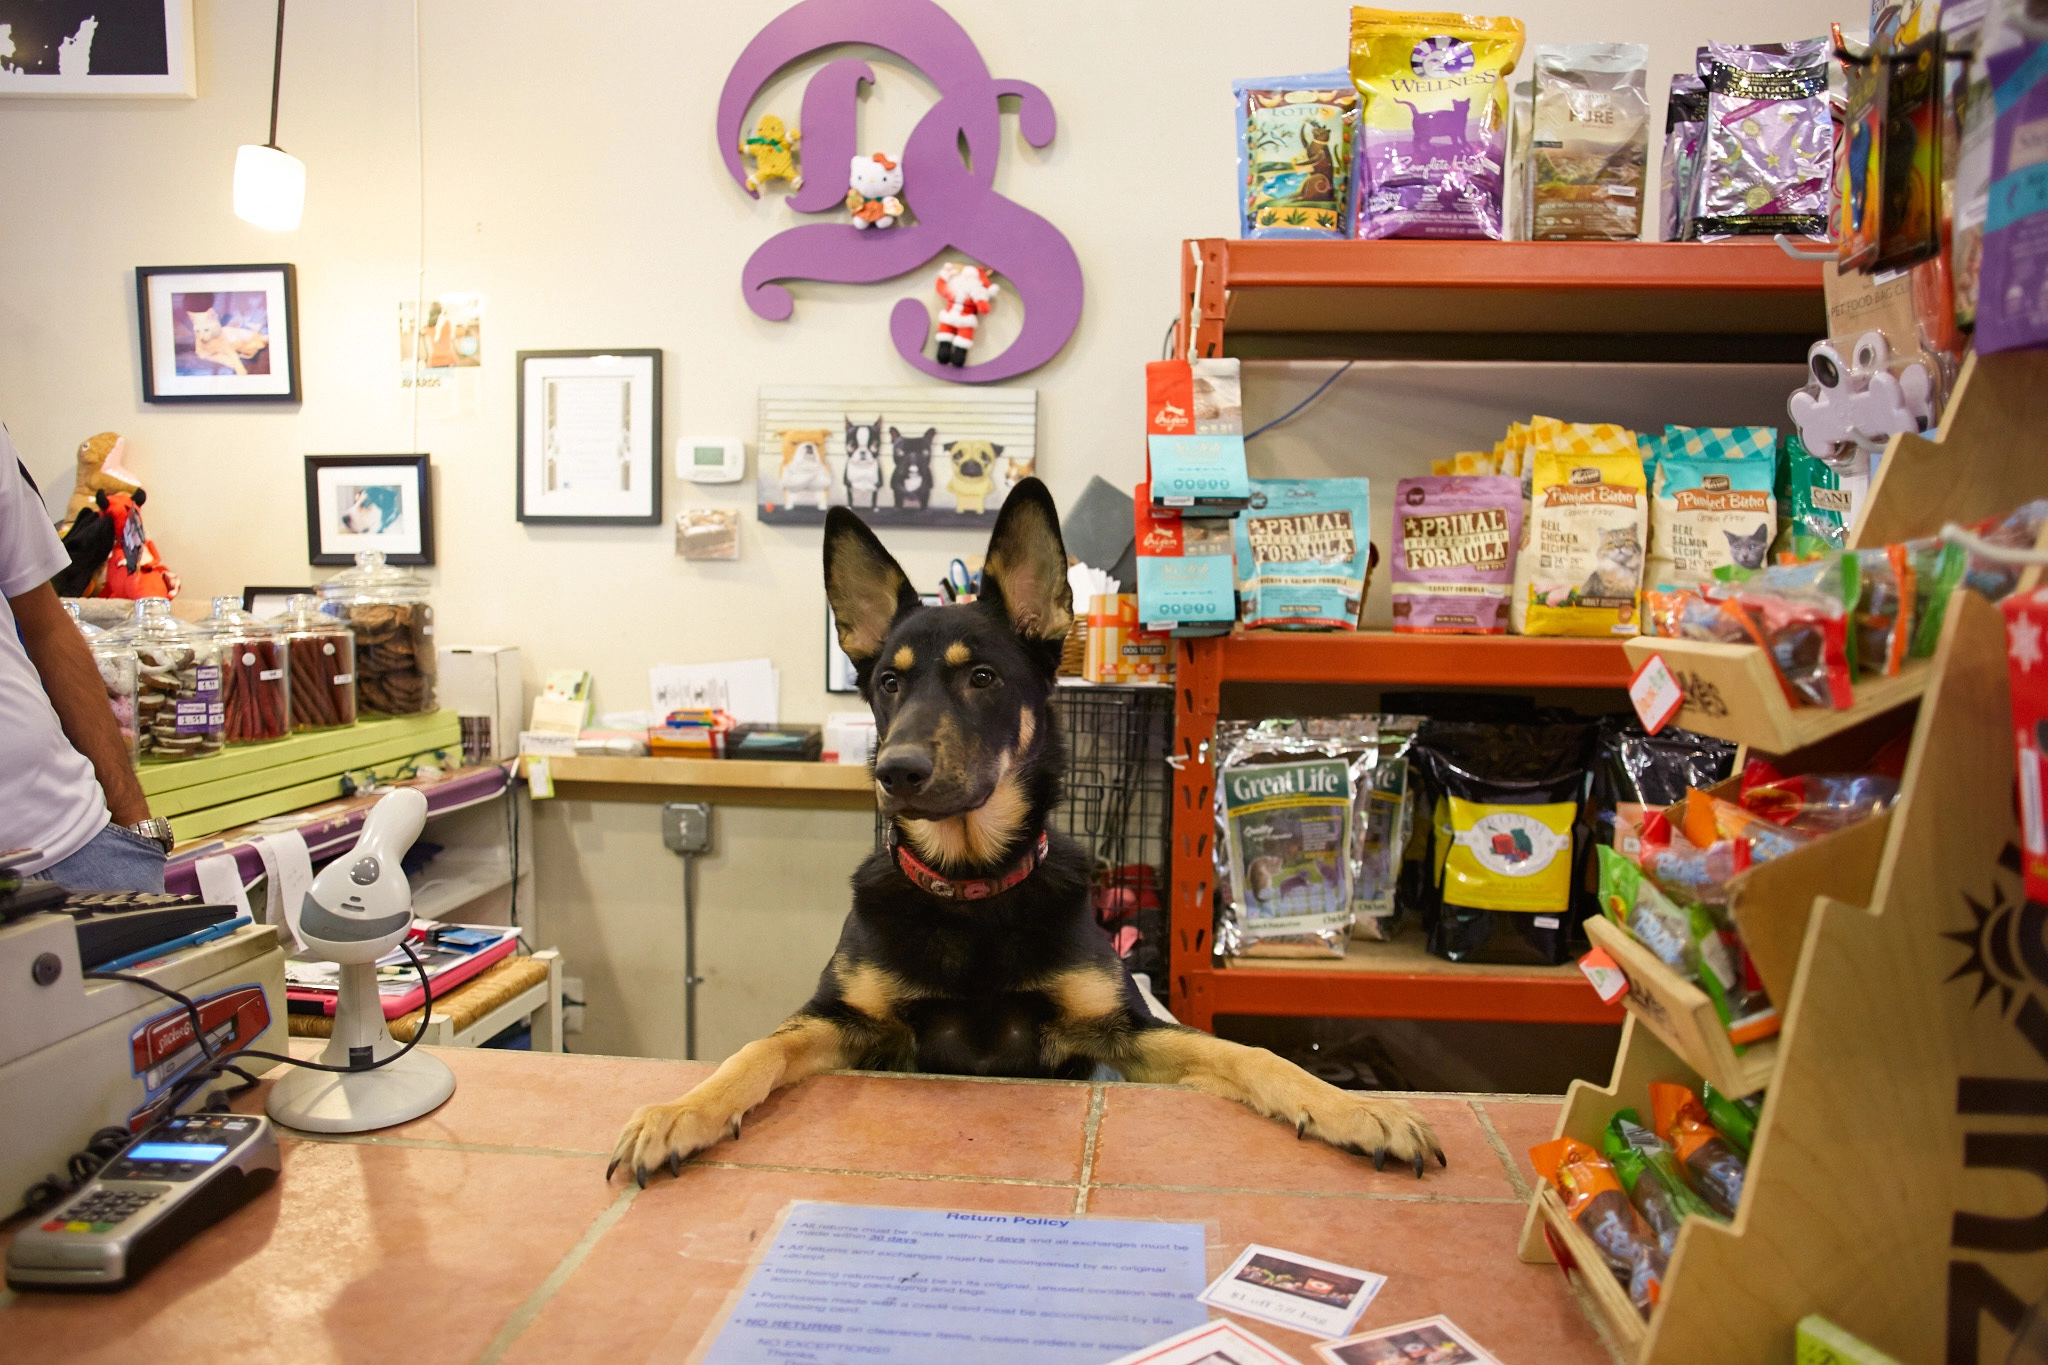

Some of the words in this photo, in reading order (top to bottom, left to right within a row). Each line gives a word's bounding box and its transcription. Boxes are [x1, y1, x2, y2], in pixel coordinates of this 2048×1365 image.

[1391, 69, 1497, 93] WELLNESS
[1272, 107, 1330, 117] LOTUS
[1569, 109, 1614, 126] PURE
[1831, 303, 1845, 317] PET
[1847, 294, 1873, 313] FOOD
[1874, 287, 1893, 304] BAG
[1265, 512, 1348, 535] PRIMAL
[1421, 511, 1504, 538] PRIMAL
[1541, 520, 1561, 530] REAL
[1672, 524, 1693, 536] REAL
[1541, 532, 1578, 543] CHICKEN
[1672, 536, 1708, 548] SALMON
[1257, 538, 1353, 562] FORMULA
[1410, 541, 1506, 570] FORMULA
[1541, 543, 1569, 554] RECIPE
[1672, 547, 1703, 559] RECIPE
[1123, 646, 1138, 655] DOG
[1140, 646, 1166, 655] TREATS
[1234, 770, 1295, 801] Great
[1296, 765, 1340, 793] Life
[947, 1212, 1007, 1223] Return
[1014, 1216, 1069, 1228] Policy
[818, 1224, 859, 1232] returns
[948, 1232, 981, 1240] within
[985, 1234, 992, 1242] 7
[995, 1235, 1026, 1244] days
[1072, 1240, 1137, 1249] exchanges
[869, 1234, 884, 1243] 30
[887, 1236, 917, 1245] days
[807, 1246, 848, 1255] returns
[878, 1251, 943, 1261] exchanges
[946, 1254, 976, 1262] must
[979, 1256, 994, 1264] be
[997, 1257, 1079, 1269] accompanied
[1083, 1262, 1098, 1271] by
[1120, 1265, 1166, 1273] original
[770, 1275, 860, 1288] accompanying
[863, 1282, 928, 1293] packaging
[930, 1286, 956, 1294] and
[805, 1270, 839, 1279] being
[842, 1272, 895, 1281] returned
[898, 1276, 929, 1284] must
[1036, 1285, 1085, 1293] unused
[1087, 1287, 1146, 1297] condition
[761, 1291, 828, 1303] Purchases
[831, 1297, 868, 1305] made
[871, 1298, 897, 1306] with
[912, 1302, 948, 1310] credit
[951, 1304, 981, 1313] card
[984, 1307, 1016, 1315] must
[1040, 1311, 1129, 1322] accompanied
[1132, 1315, 1148, 1324] by
[1152, 1317, 1174, 1325] the
[745, 1318, 768, 1328] NO
[770, 1320, 843, 1333] RETURNS
[867, 1327, 932, 1338] clearance
[980, 1335, 1029, 1344] custom
[1033, 1339, 1077, 1348] orders
[1081, 1341, 1094, 1349] or
[757, 1338, 781, 1347] NO
